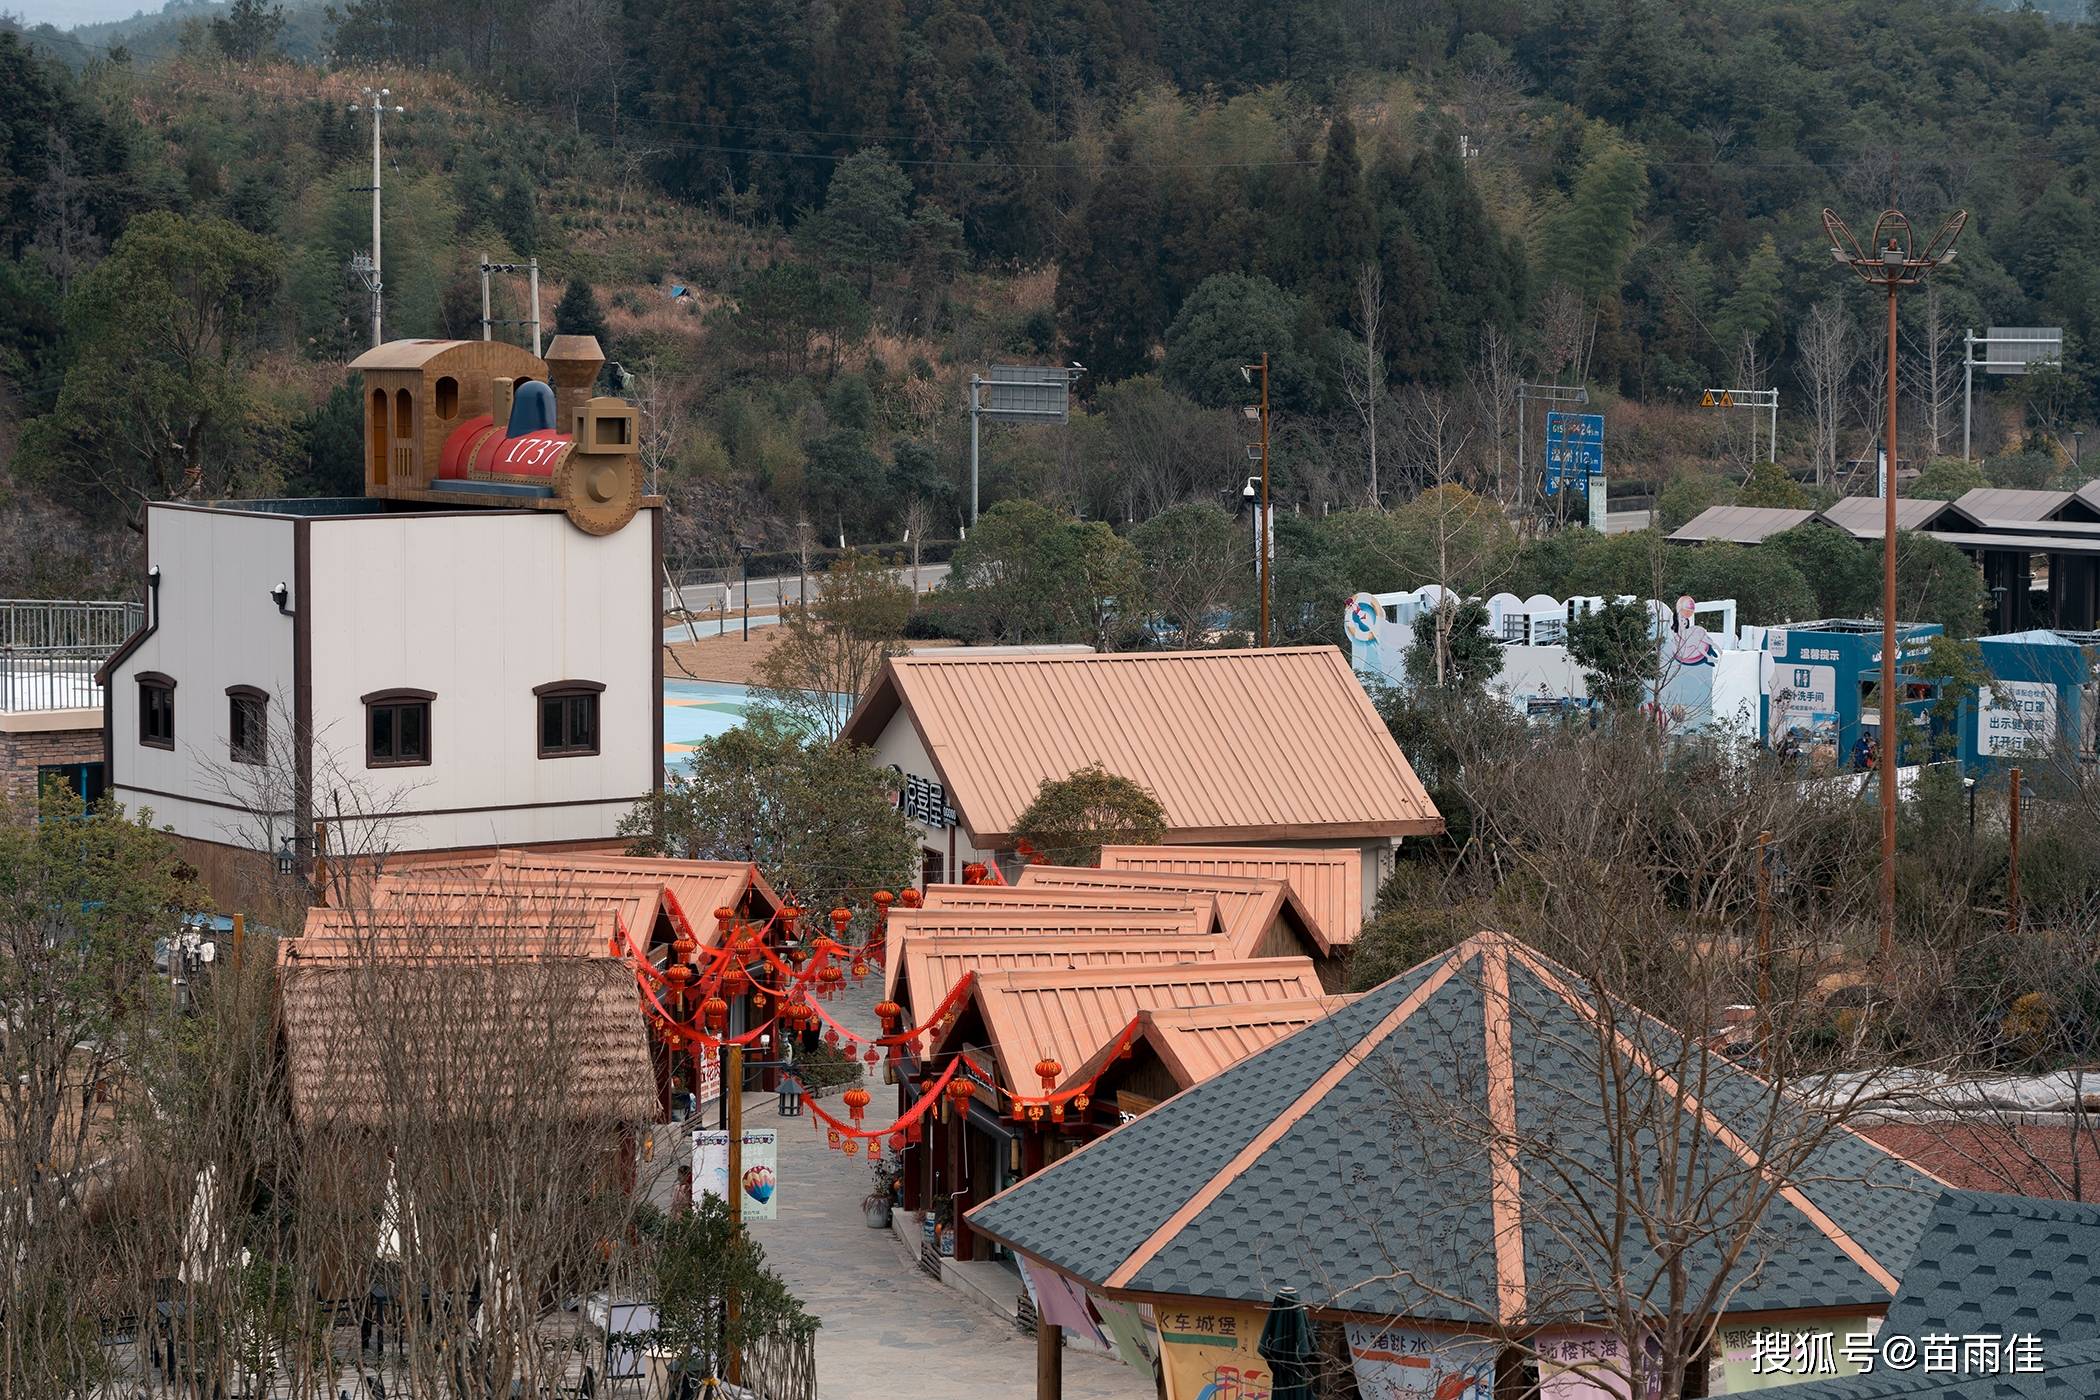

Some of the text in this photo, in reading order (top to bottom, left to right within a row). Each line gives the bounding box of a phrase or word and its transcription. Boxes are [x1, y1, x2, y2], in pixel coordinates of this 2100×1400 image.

[505, 438, 567, 465] 1737
[1800, 648, 1840, 661] 温馨提示
[1159, 1311, 1237, 1336] 火车城堡
[1351, 1330, 1427, 1353] 小猪跳水
